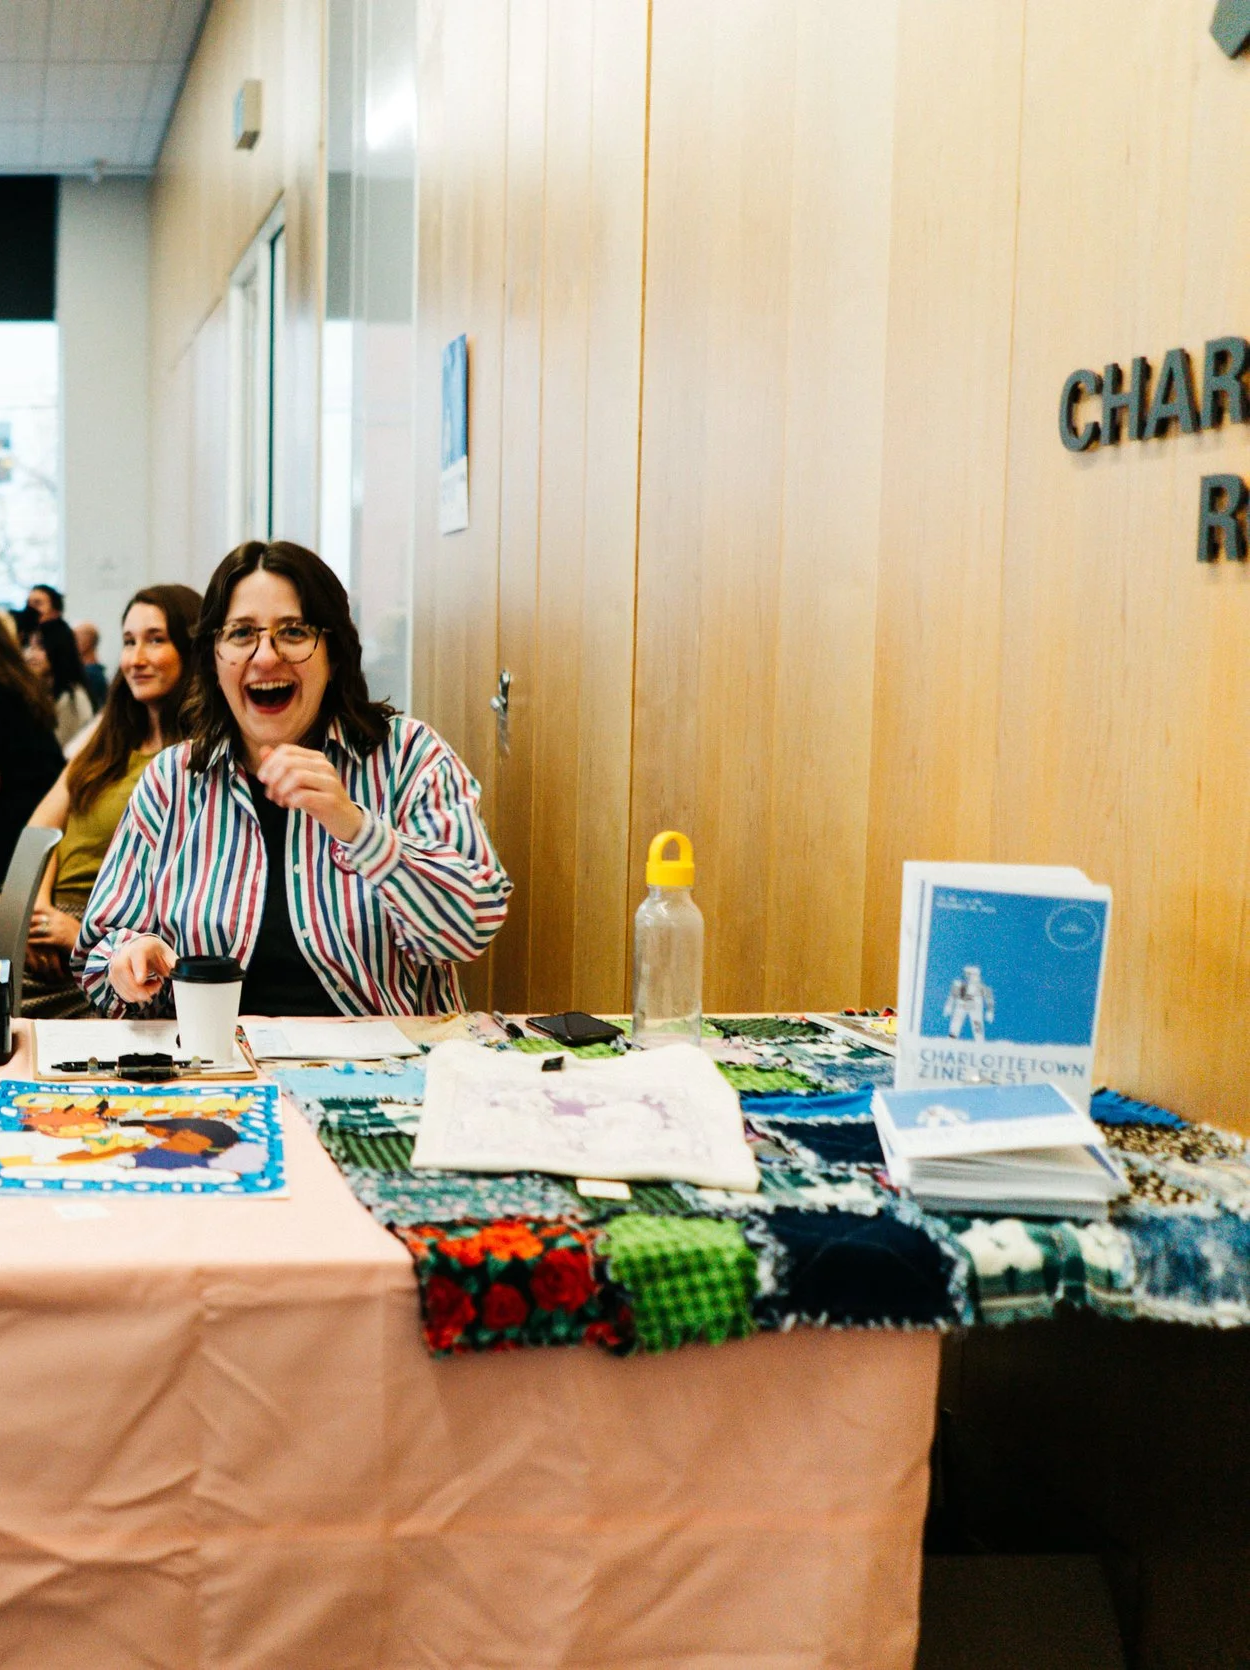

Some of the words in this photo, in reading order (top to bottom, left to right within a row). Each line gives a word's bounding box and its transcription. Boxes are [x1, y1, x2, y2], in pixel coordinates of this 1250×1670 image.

[1197, 473, 1250, 562] R
[918, 1062, 967, 1082] ZINE
[919, 1048, 1086, 1077] CHARLOTTETOWN
